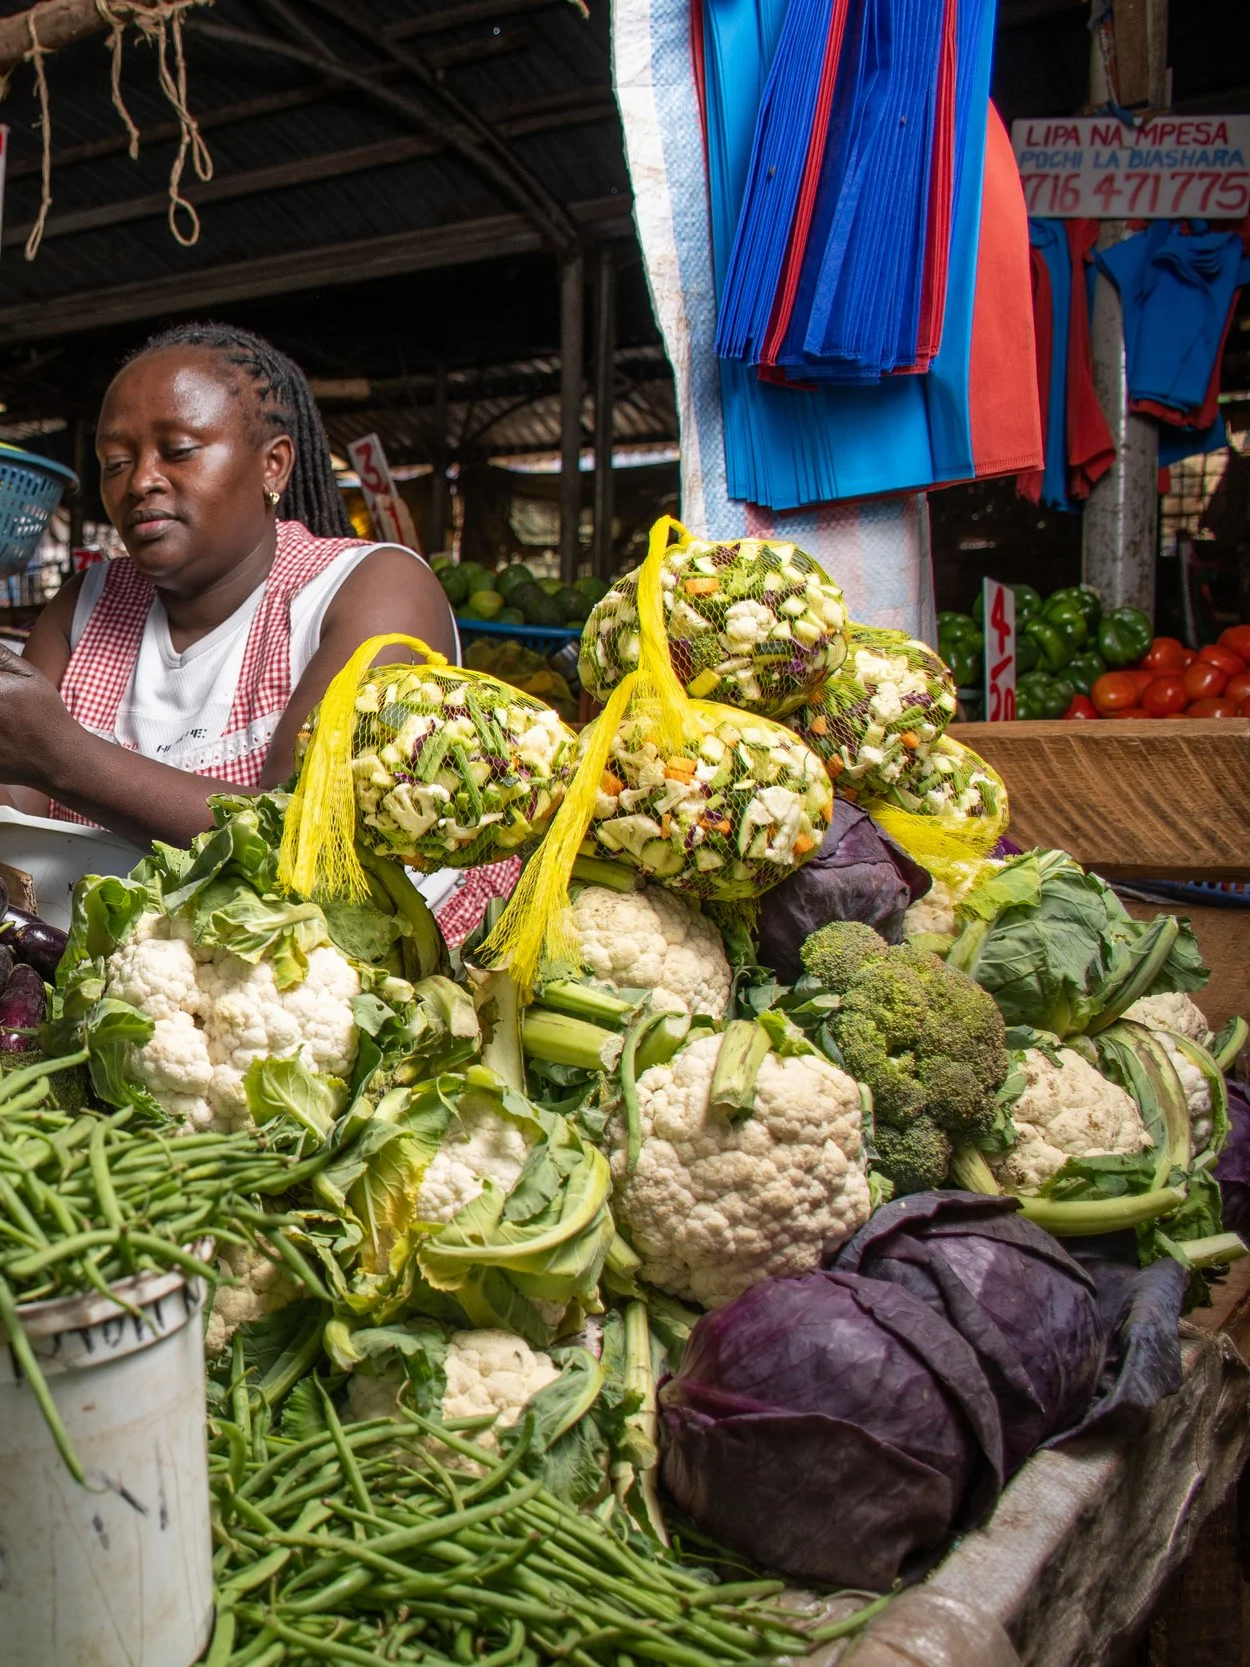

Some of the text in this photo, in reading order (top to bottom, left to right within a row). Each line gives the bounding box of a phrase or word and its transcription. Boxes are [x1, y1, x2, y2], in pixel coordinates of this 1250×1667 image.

[1026, 121, 1228, 147] LIPA NA MPESA
[1019, 149, 1245, 170] POCHI LA BIASHARA
[1092, 172, 1161, 213] 471
[1169, 171, 1250, 213] 775
